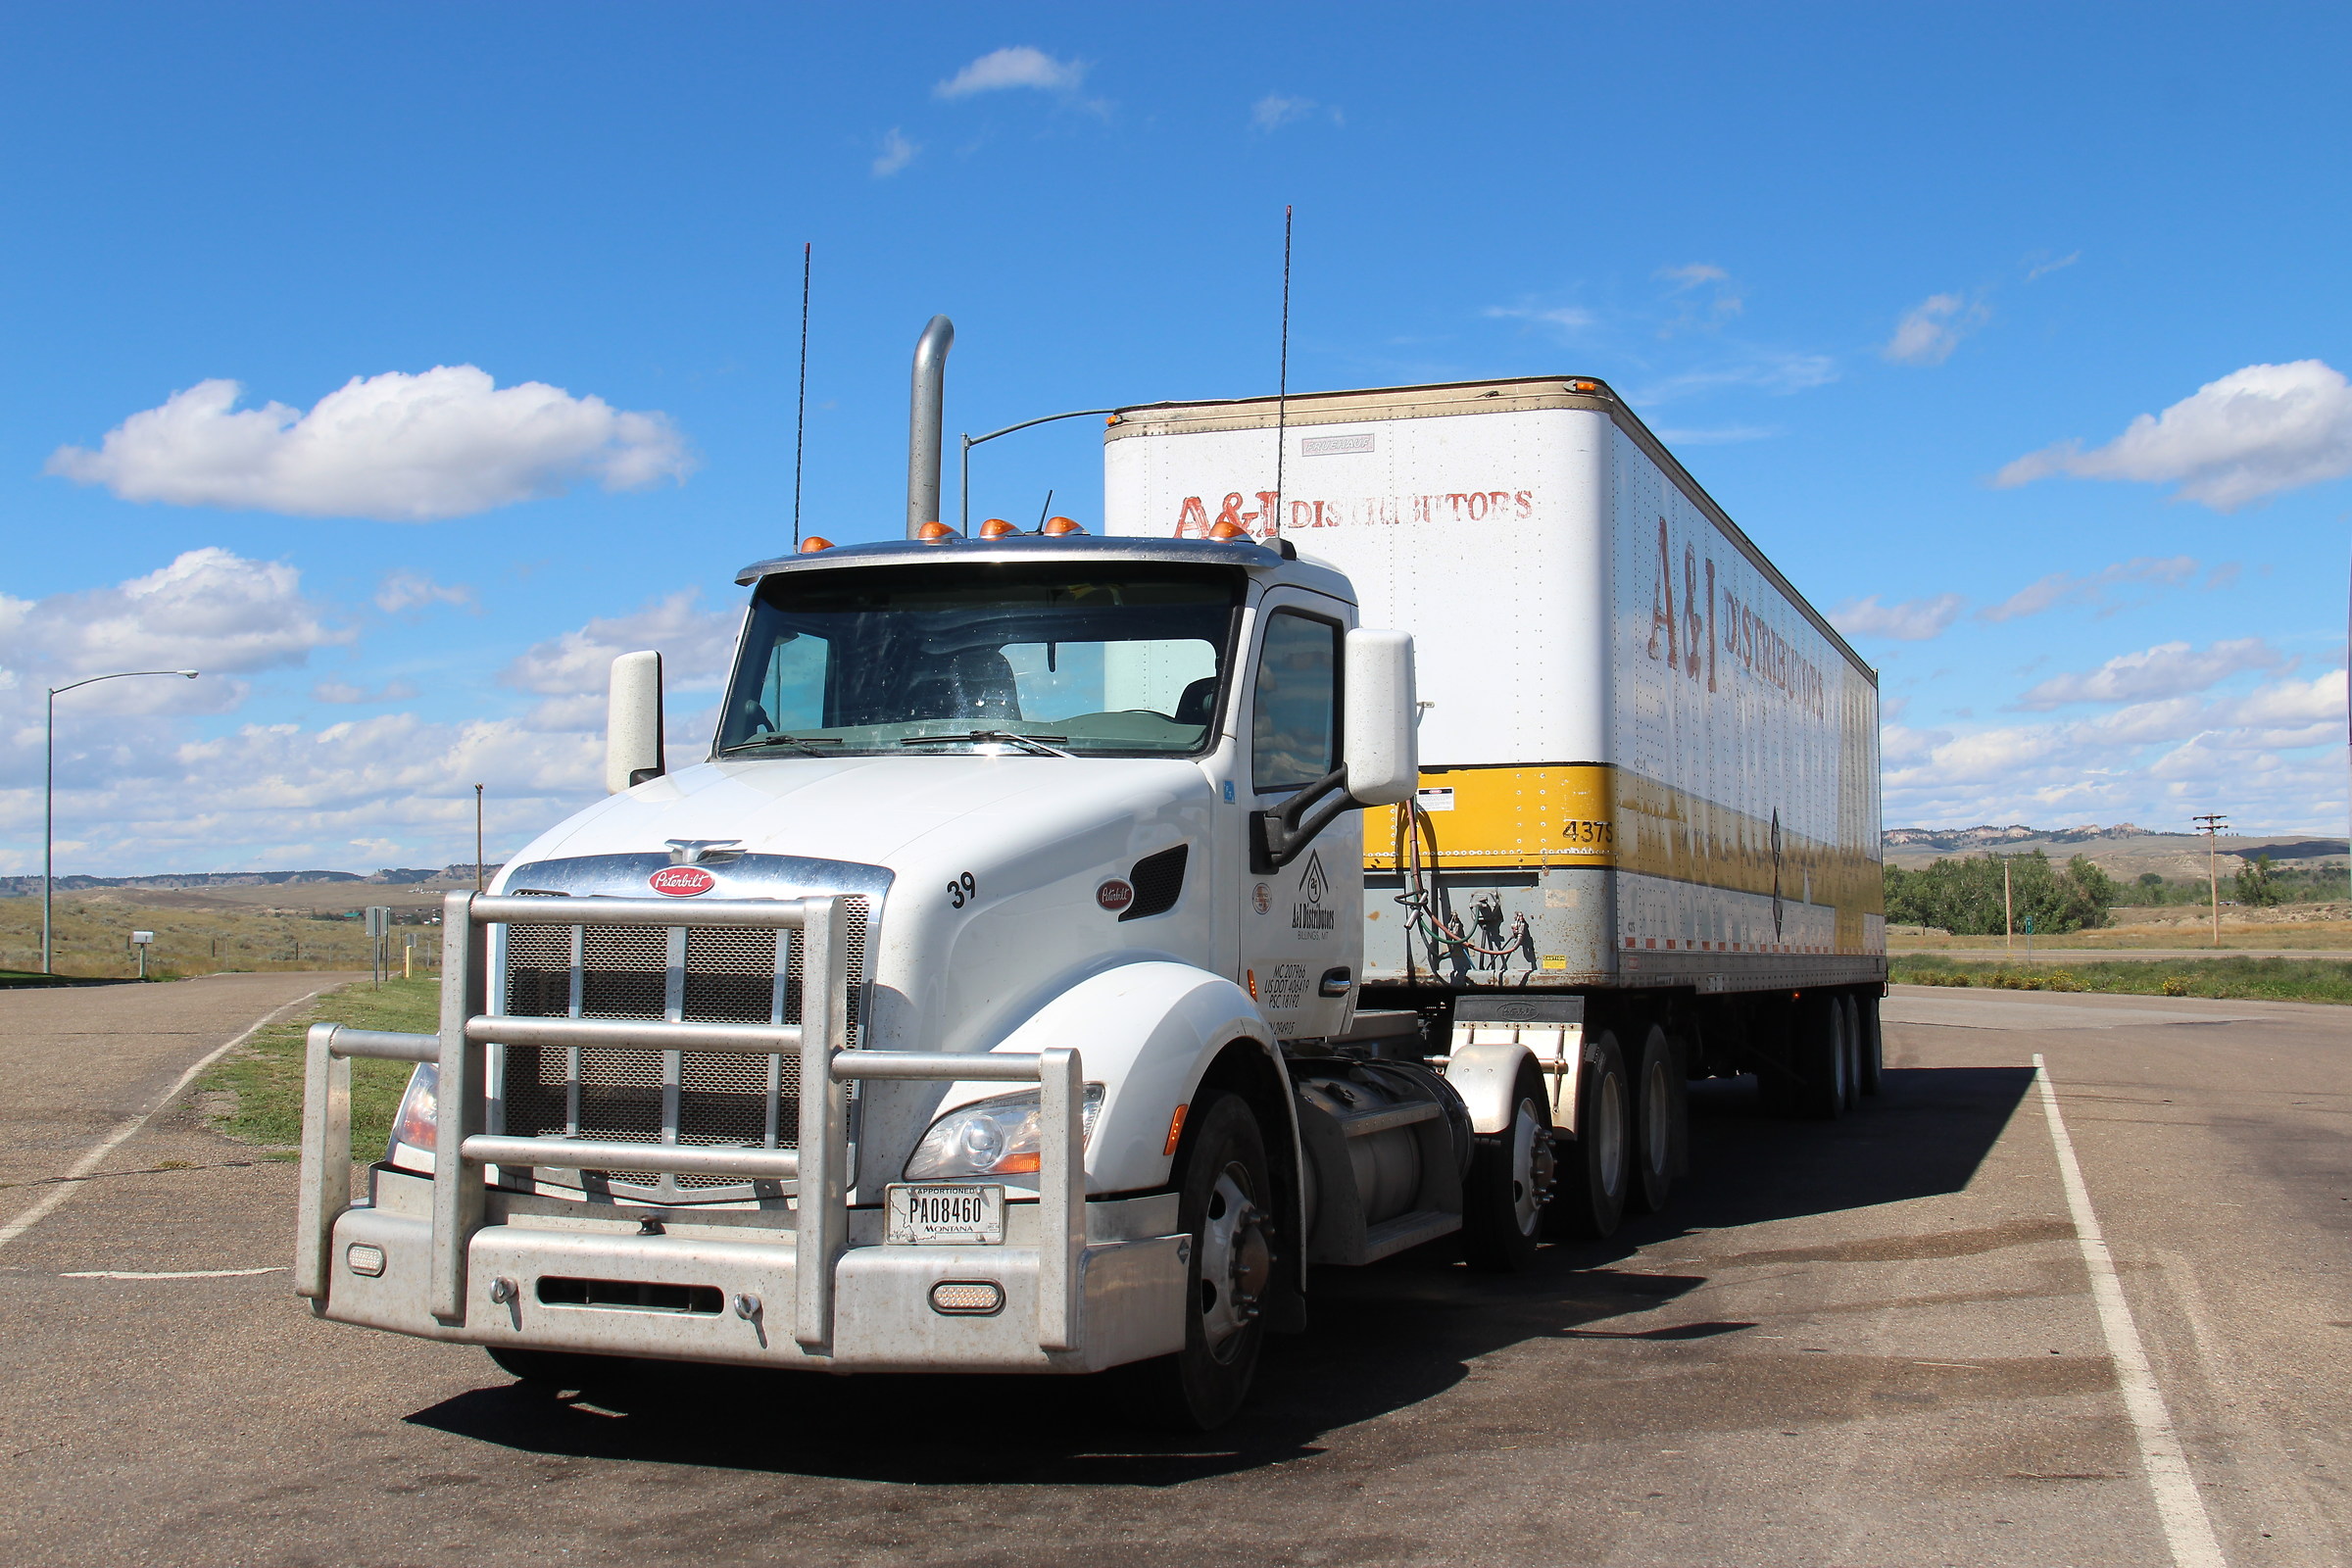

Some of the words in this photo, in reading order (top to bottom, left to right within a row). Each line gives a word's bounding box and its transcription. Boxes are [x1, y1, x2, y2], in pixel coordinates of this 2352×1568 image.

[1305, 437, 1370, 451] FRUEHAUF
[1173, 491, 1280, 539] A&I
[1288, 490, 1534, 528] DISRIBUTORS
[1648, 515, 1716, 694] A&I
[1724, 586, 1825, 719] DISTRIBUTORS
[655, 871, 710, 889] Peterbilt
[947, 871, 976, 909] 39
[1102, 887, 1129, 904] Peterbilt
[1302, 903, 1334, 930] Distributors
[1273, 964, 1285, 978] MC
[1264, 979, 1273, 994] US
[1273, 979, 1289, 994] DOT
[1268, 994, 1283, 1008] PSC
[1282, 994, 1300, 1008] 18192
[909, 1198, 981, 1224] PA08460
